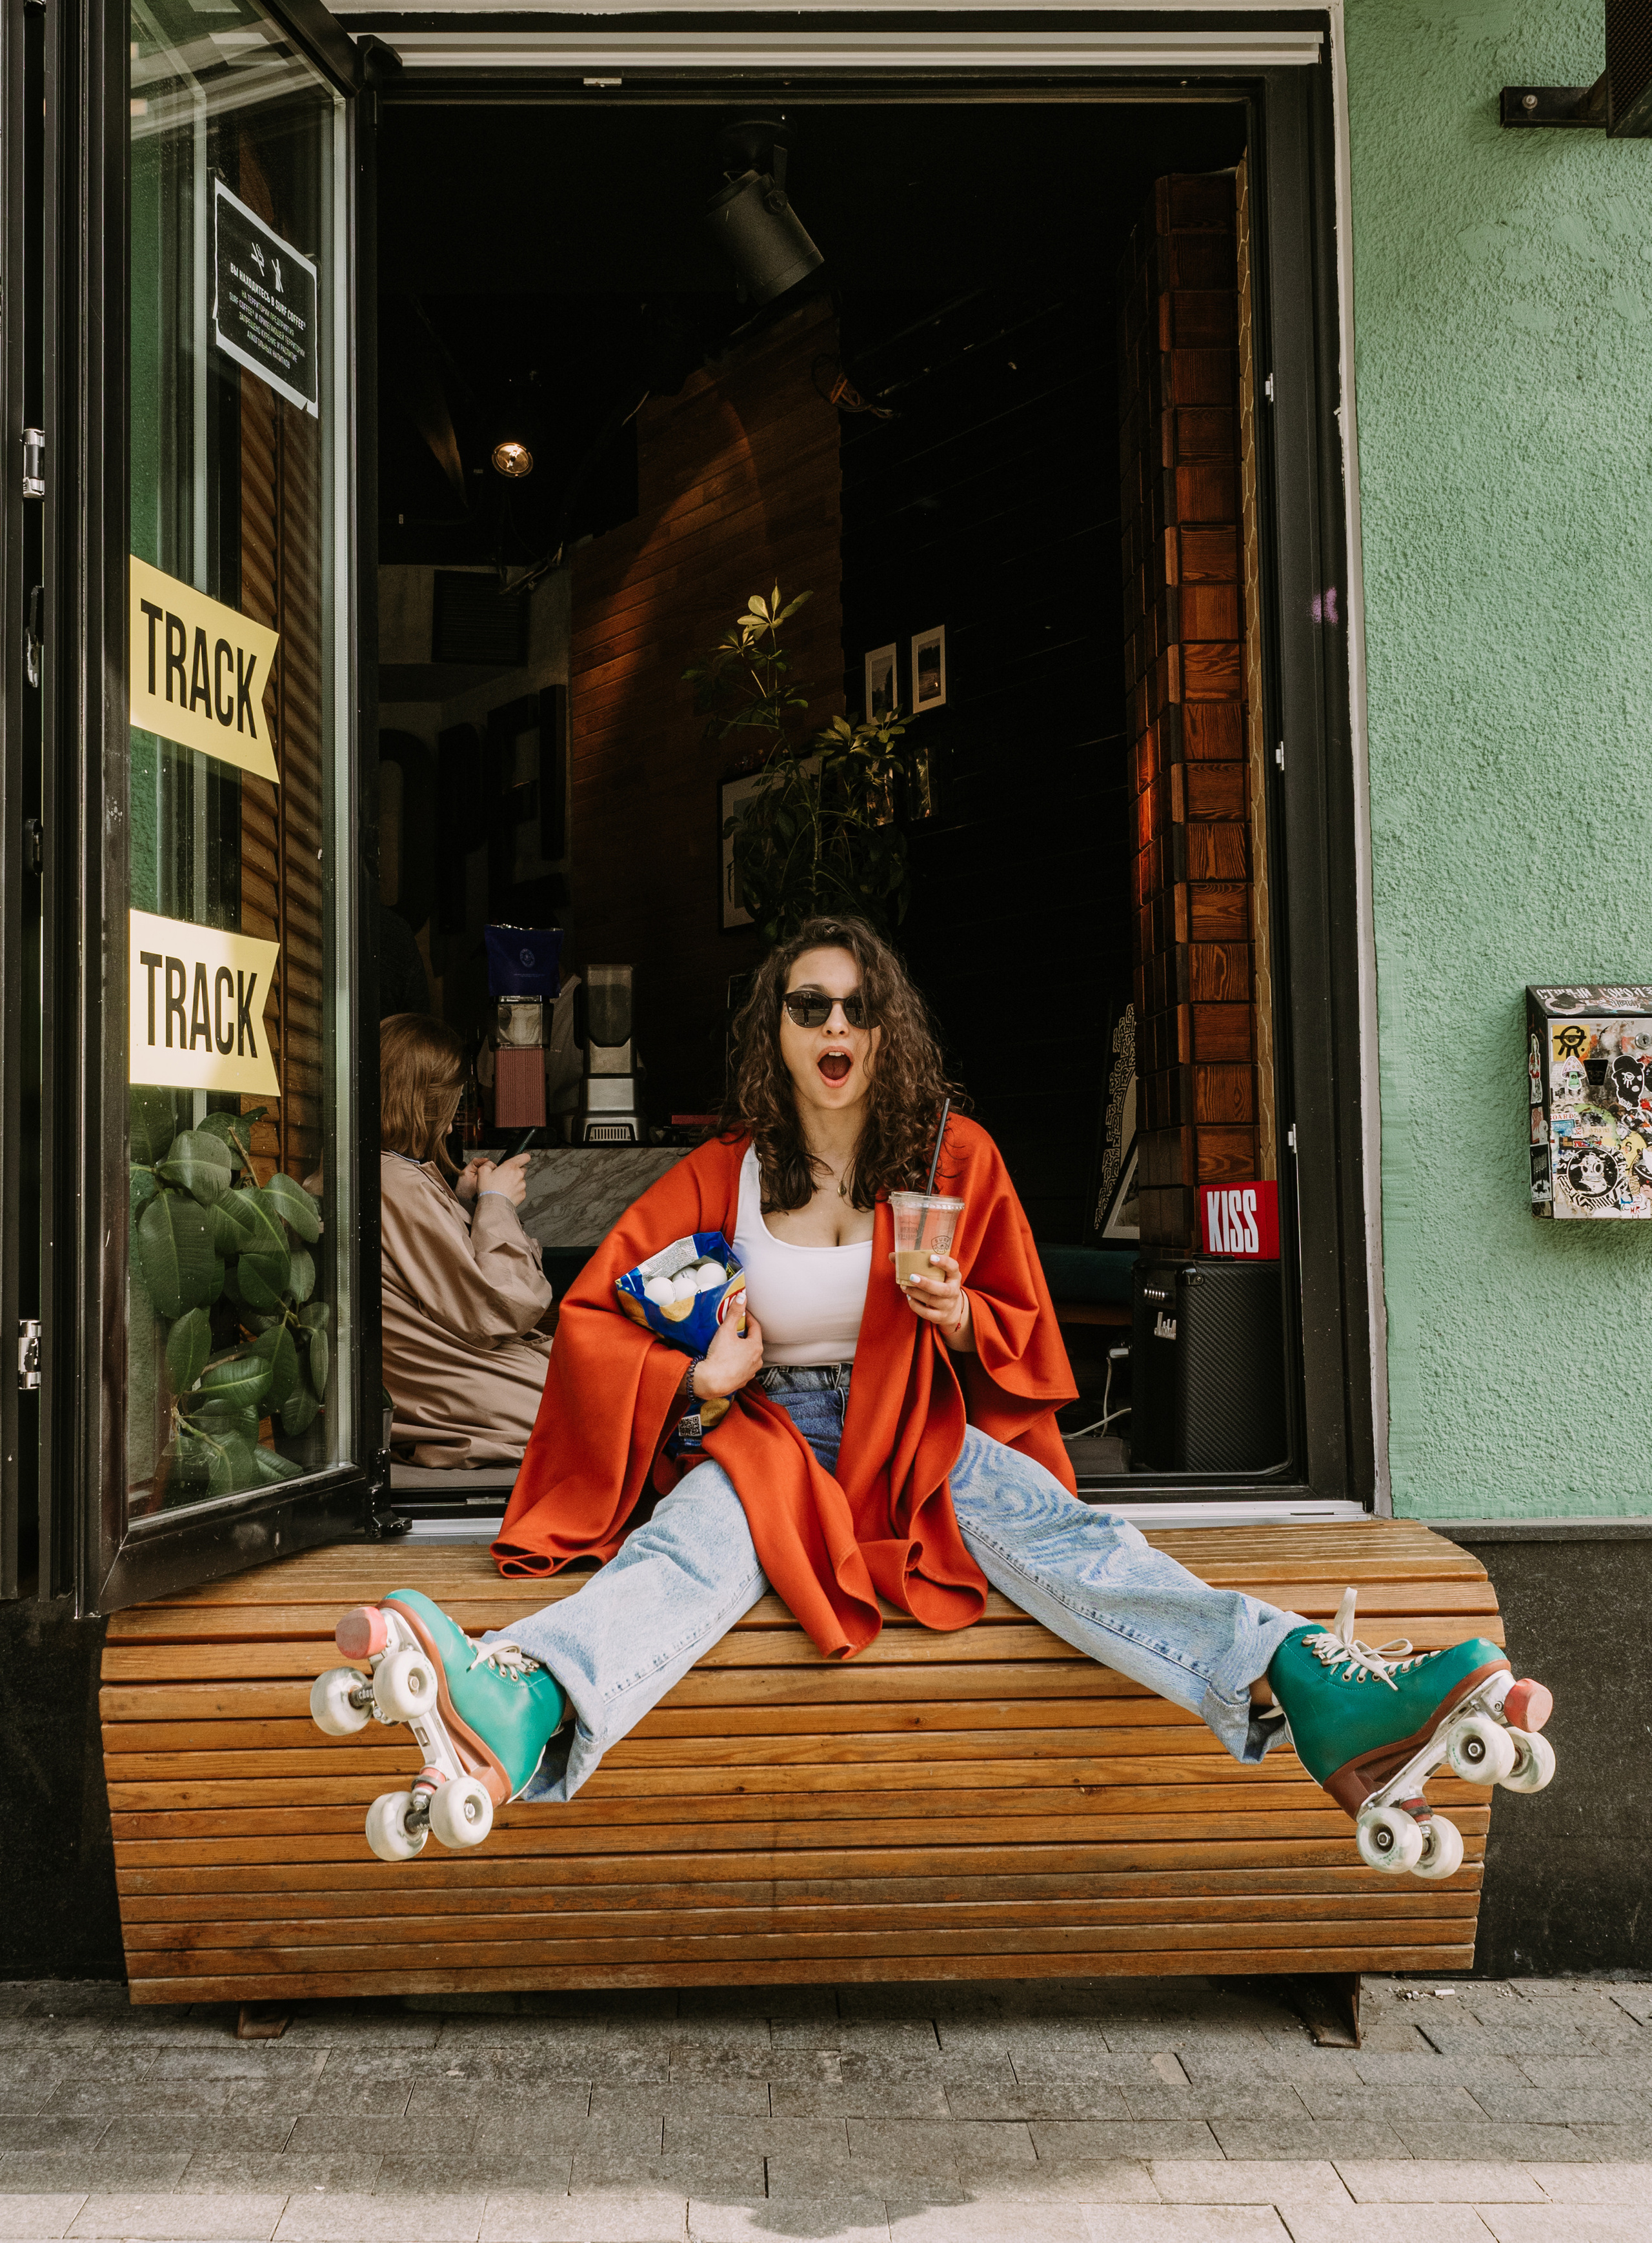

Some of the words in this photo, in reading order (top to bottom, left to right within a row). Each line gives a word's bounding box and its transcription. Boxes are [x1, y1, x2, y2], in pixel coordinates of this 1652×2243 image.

[239, 269, 270, 304] НАХОДИТЕСЬ
[274, 299, 287, 317] SURF
[141, 598, 257, 739] TRACK
[141, 951, 258, 1058] TRACK
[1207, 1189, 1259, 1253] KISS
